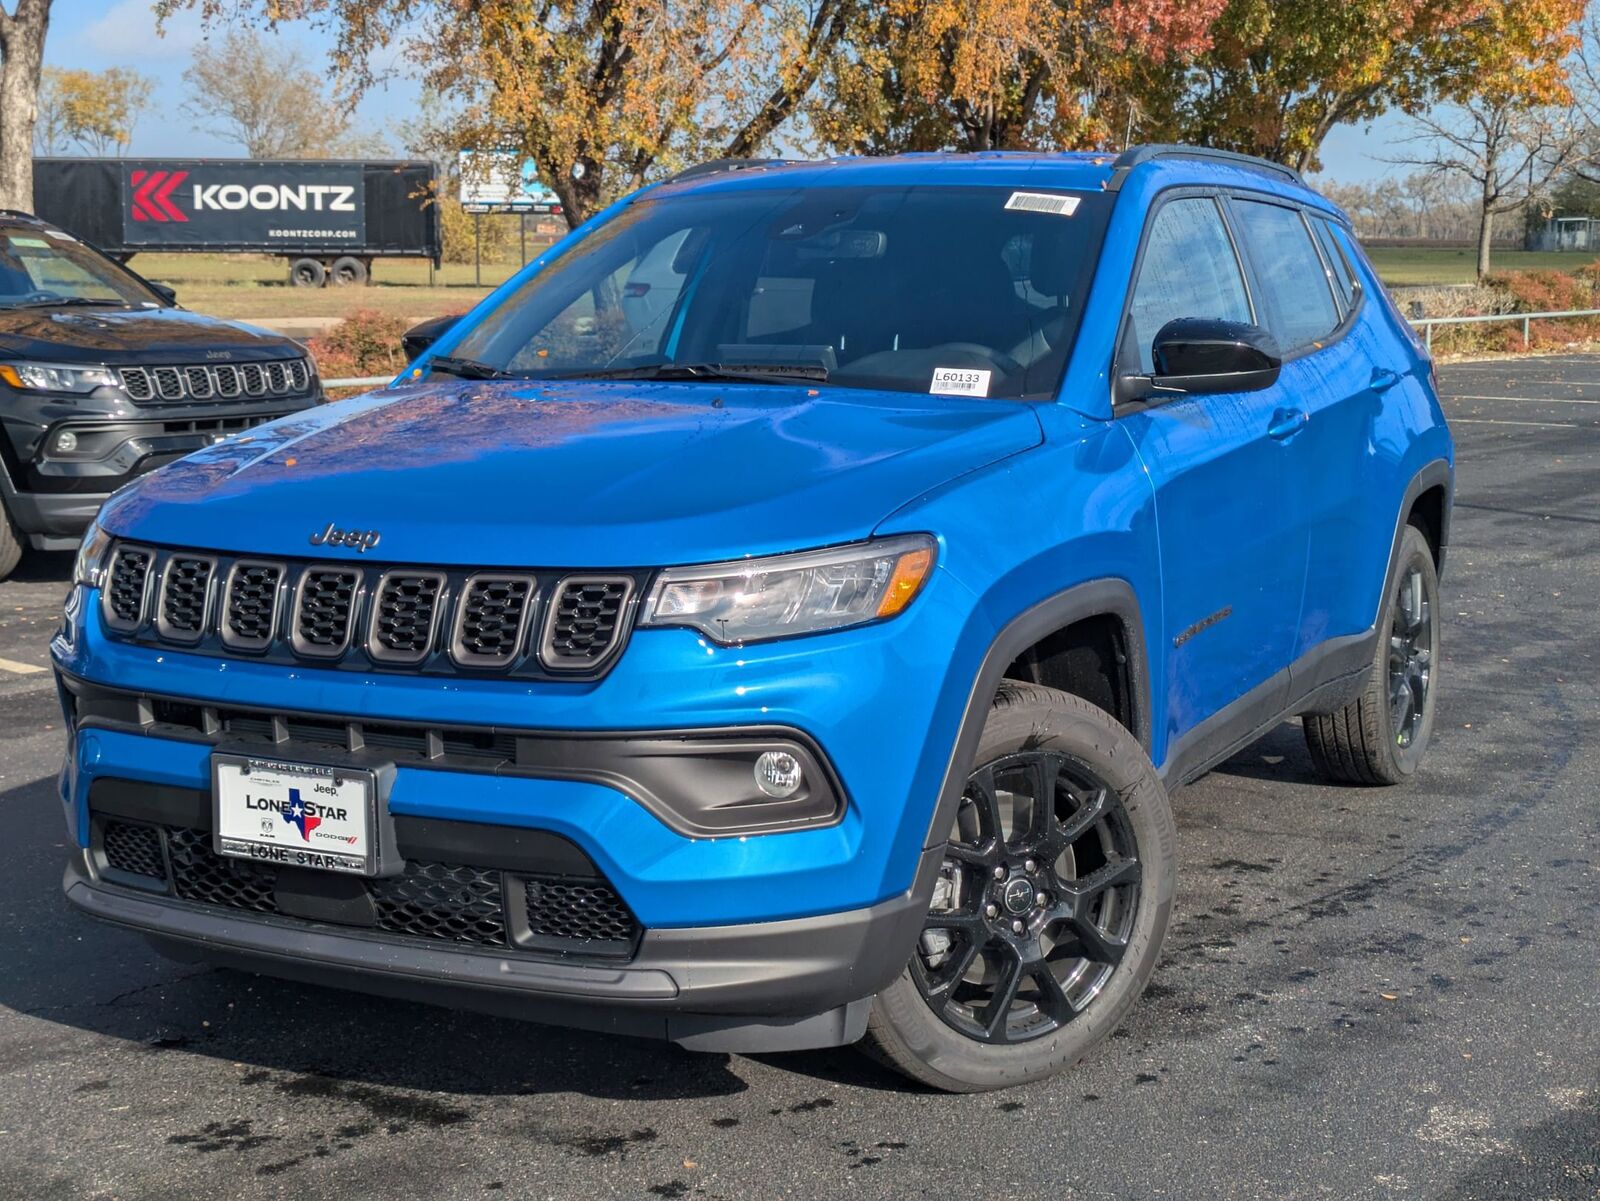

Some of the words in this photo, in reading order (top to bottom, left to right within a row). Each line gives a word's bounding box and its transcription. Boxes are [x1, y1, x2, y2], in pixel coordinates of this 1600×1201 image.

[193, 184, 356, 211] KOONTZ
[268, 229, 357, 238] KOONTZCORP.COM
[935, 372, 980, 383] L60133
[309, 522, 381, 553] Jeep
[314, 783, 338, 797] Jeep
[246, 795, 291, 815] LONE
[304, 801, 347, 822] STAR
[250, 845, 288, 862] LONE
[296, 852, 336, 869] STAR
